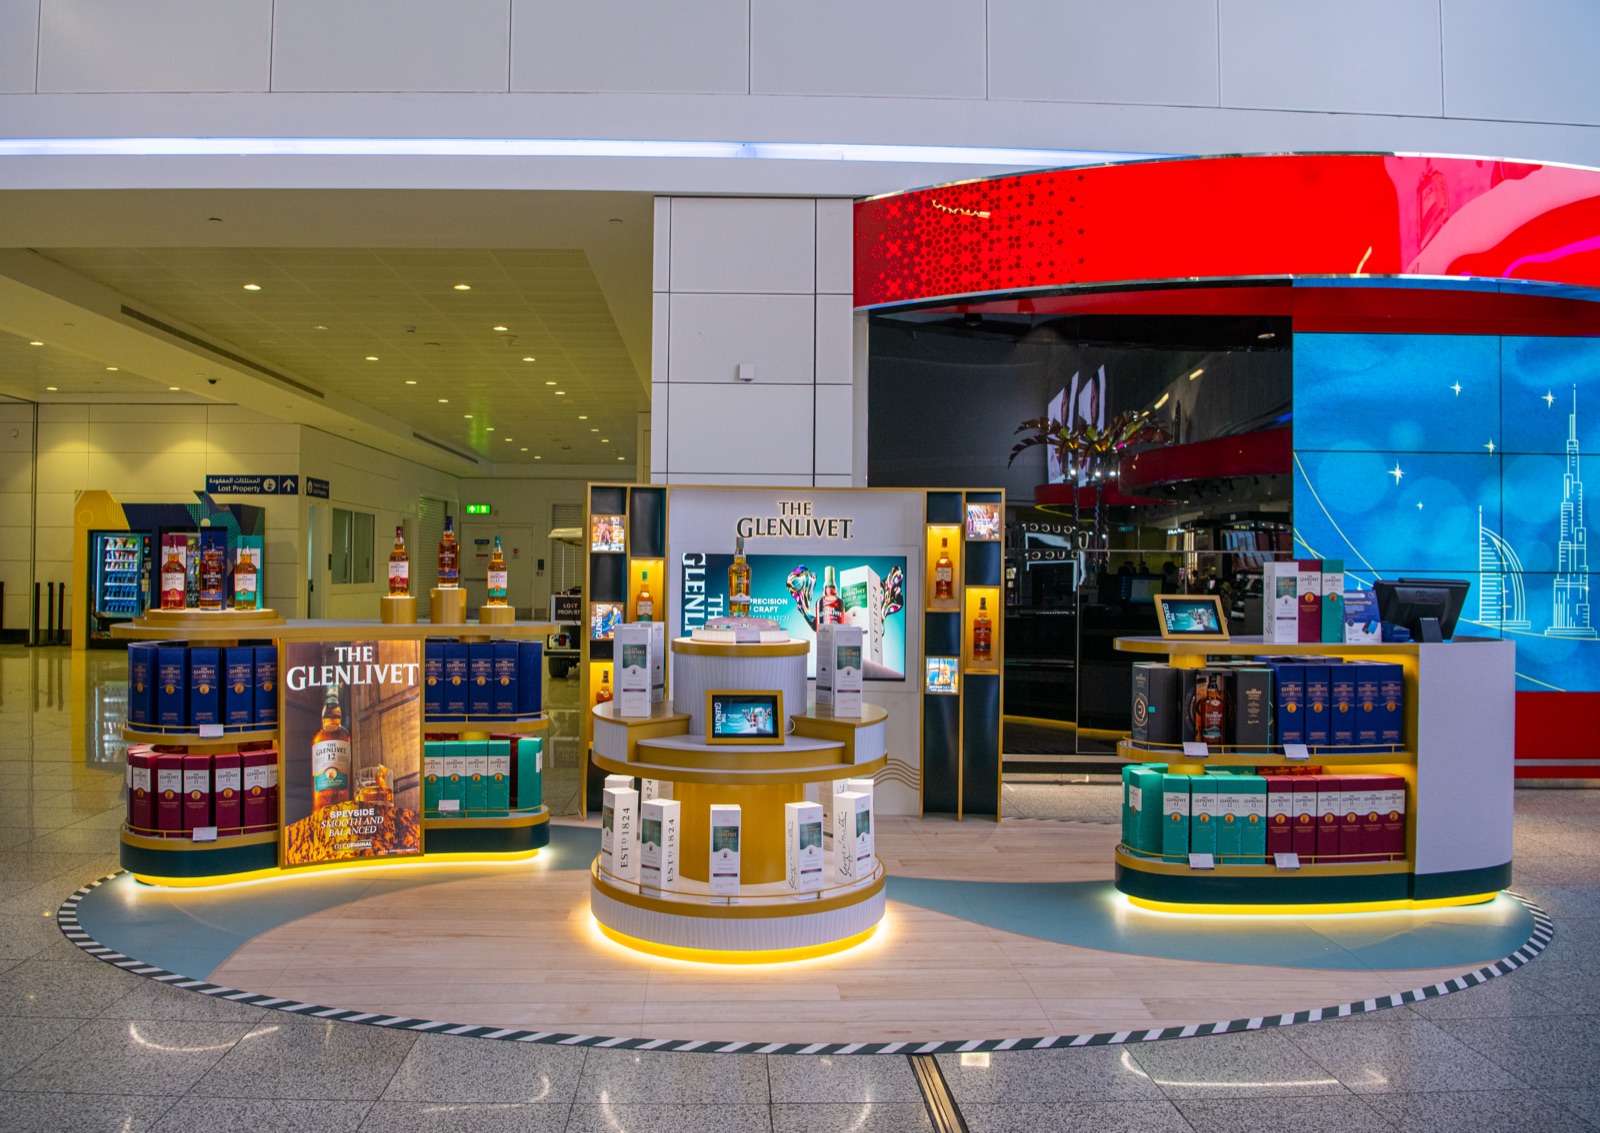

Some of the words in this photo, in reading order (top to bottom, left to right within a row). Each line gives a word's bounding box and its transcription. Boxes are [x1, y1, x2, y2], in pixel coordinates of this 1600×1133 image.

[778, 501, 812, 516] THE
[682, 552, 706, 632] GLENLI
[708, 594, 724, 620] TH
[334, 646, 373, 662] THE
[286, 663, 420, 690] GLENLIVET
[316, 747, 346, 756] GLENLIVET
[330, 808, 375, 818] SPEYSIDE
[321, 817, 362, 829] SMOOTH
[363, 816, 384, 826] AND
[622, 808, 630, 836] 1824
[329, 826, 377, 837] BALANCED
